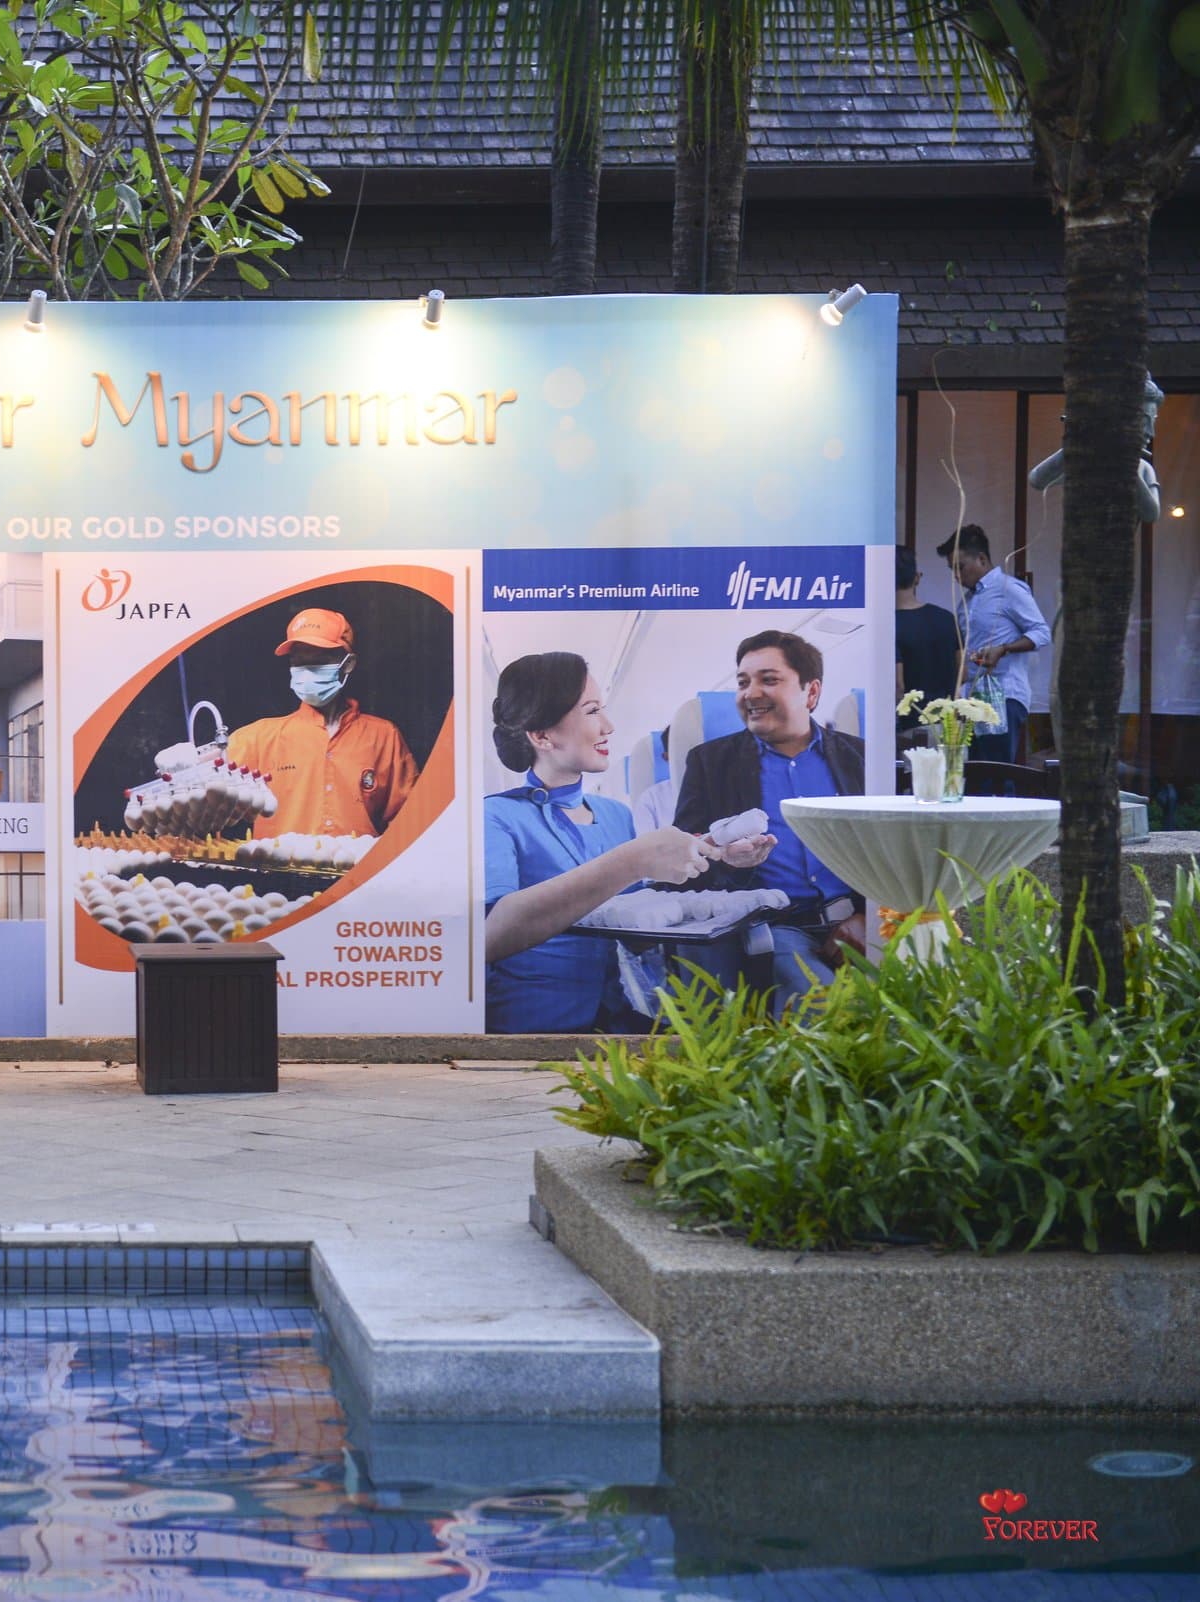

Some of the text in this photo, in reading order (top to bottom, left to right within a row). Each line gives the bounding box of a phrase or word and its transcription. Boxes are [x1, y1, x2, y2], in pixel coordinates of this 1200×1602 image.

[81, 370, 518, 473] Myanmar
[7, 517, 72, 540] OUR
[81, 516, 165, 539] GOLD
[174, 515, 341, 538] SPONSORS
[493, 583, 700, 602] Myanmar's Premium Airline
[746, 575, 853, 601] FMI Air
[116, 602, 191, 620] JAPFA
[336, 921, 443, 938] GROWING
[334, 945, 443, 962] TOWARDS
[305, 970, 443, 987] PROSPERITY
